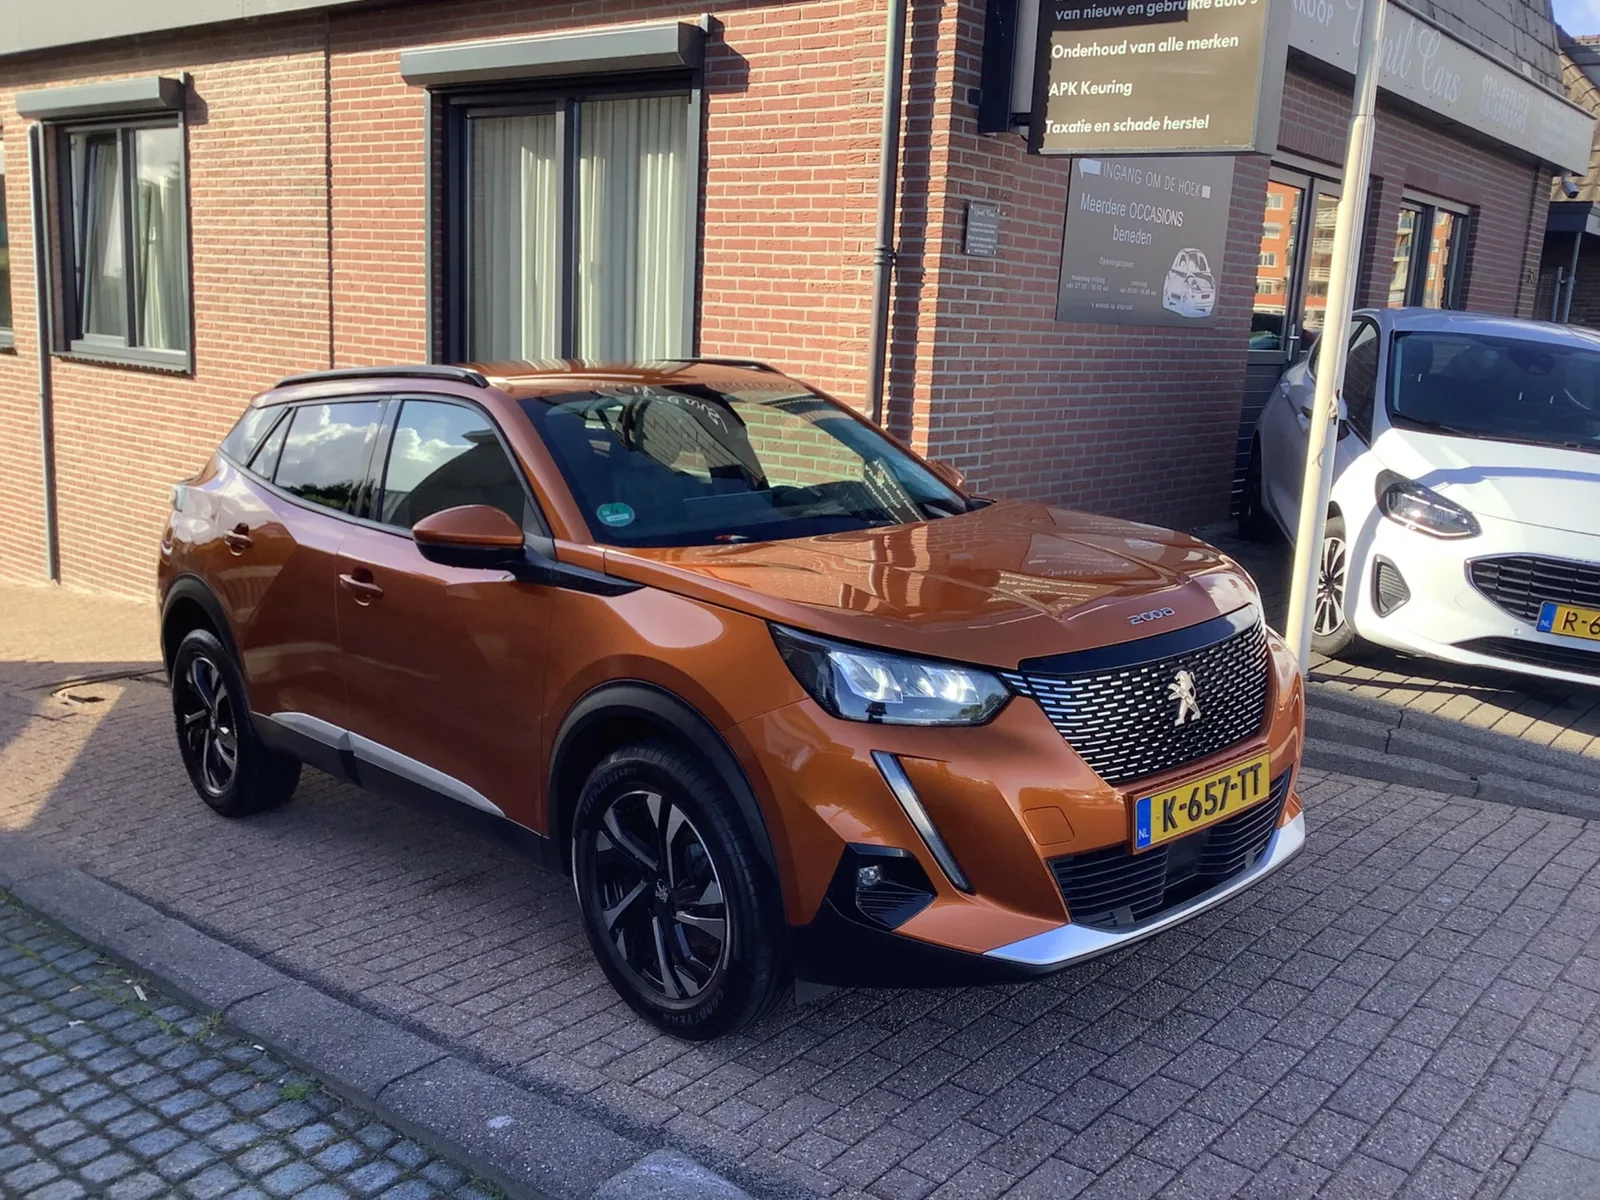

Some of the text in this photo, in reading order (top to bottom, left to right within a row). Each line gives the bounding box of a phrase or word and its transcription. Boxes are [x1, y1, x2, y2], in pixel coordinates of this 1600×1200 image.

[1055, 9, 1081, 20] van
[1082, 7, 1125, 19] nieuw
[1127, 4, 1144, 15] en
[1051, 33, 1239, 59] Onderhoud van alle merken
[1418, 28, 1460, 103] Cars
[1048, 79, 1133, 97] APK Keuring
[1045, 114, 1210, 134] Taxatie en schade herstel
[1103, 161, 1201, 197] INGANG OM DE HOEK
[1080, 192, 1184, 227] Meerdere OCCASIONS
[1113, 223, 1152, 245] beneden
[1127, 606, 1176, 625] 2008
[1163, 762, 1262, 833] K-657-TT
[1138, 826, 1149, 840] NL
